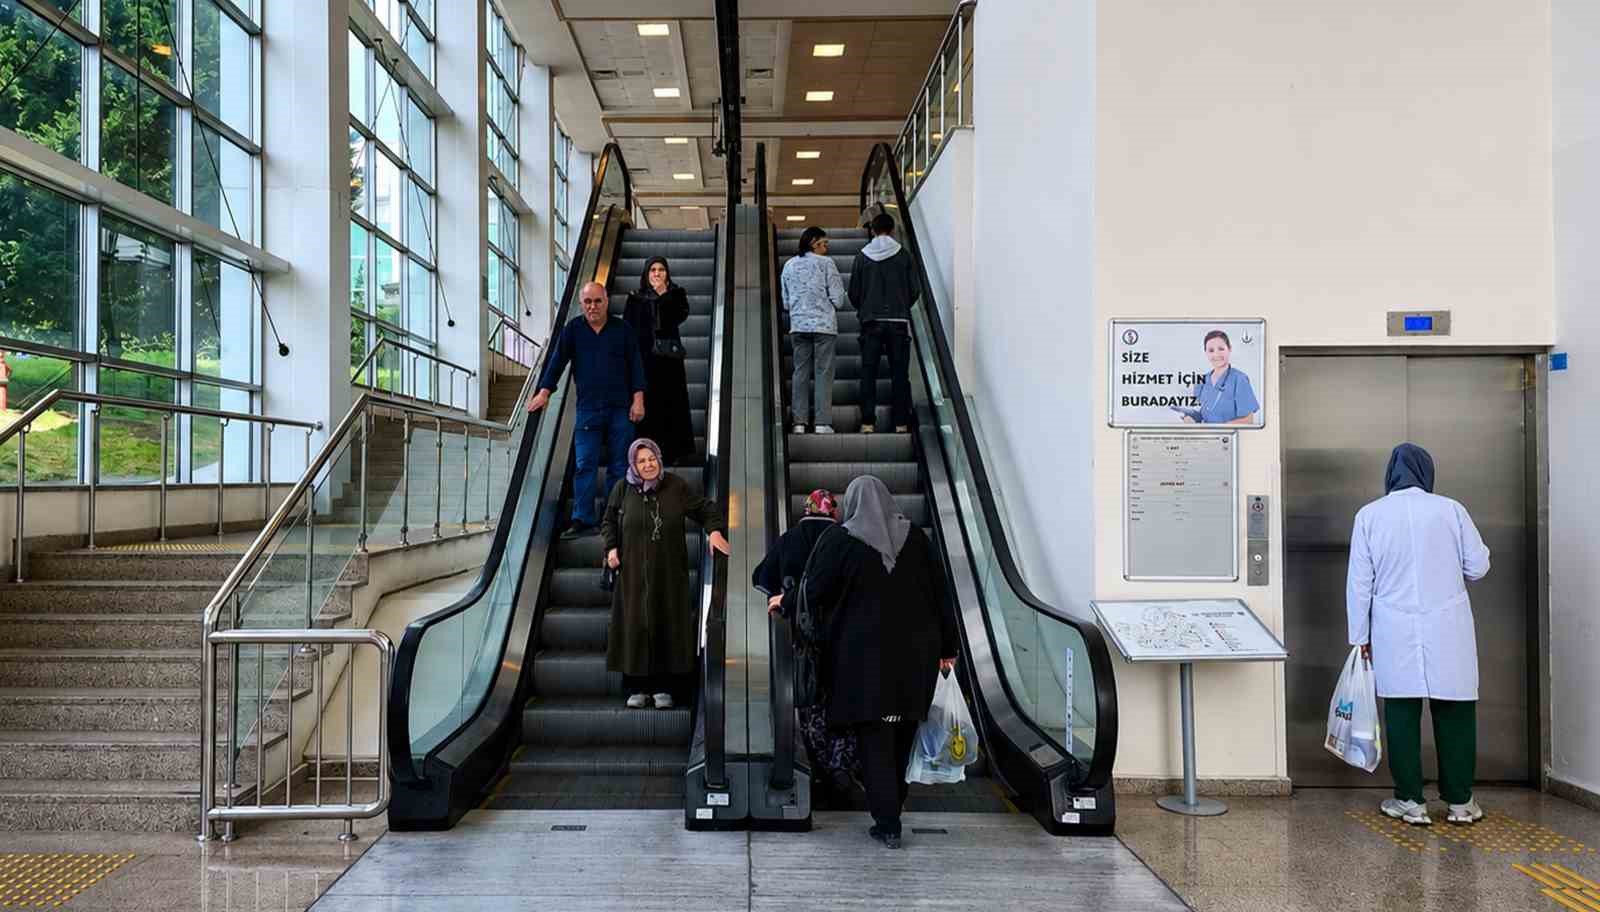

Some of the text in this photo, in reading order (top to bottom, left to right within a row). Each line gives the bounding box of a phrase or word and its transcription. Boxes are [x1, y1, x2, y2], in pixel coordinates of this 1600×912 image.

[1121, 350, 1150, 363] SİZE
[1121, 371, 1206, 388] HİZMET İÇİN
[1121, 395, 1202, 407] BURADAYIZ.
